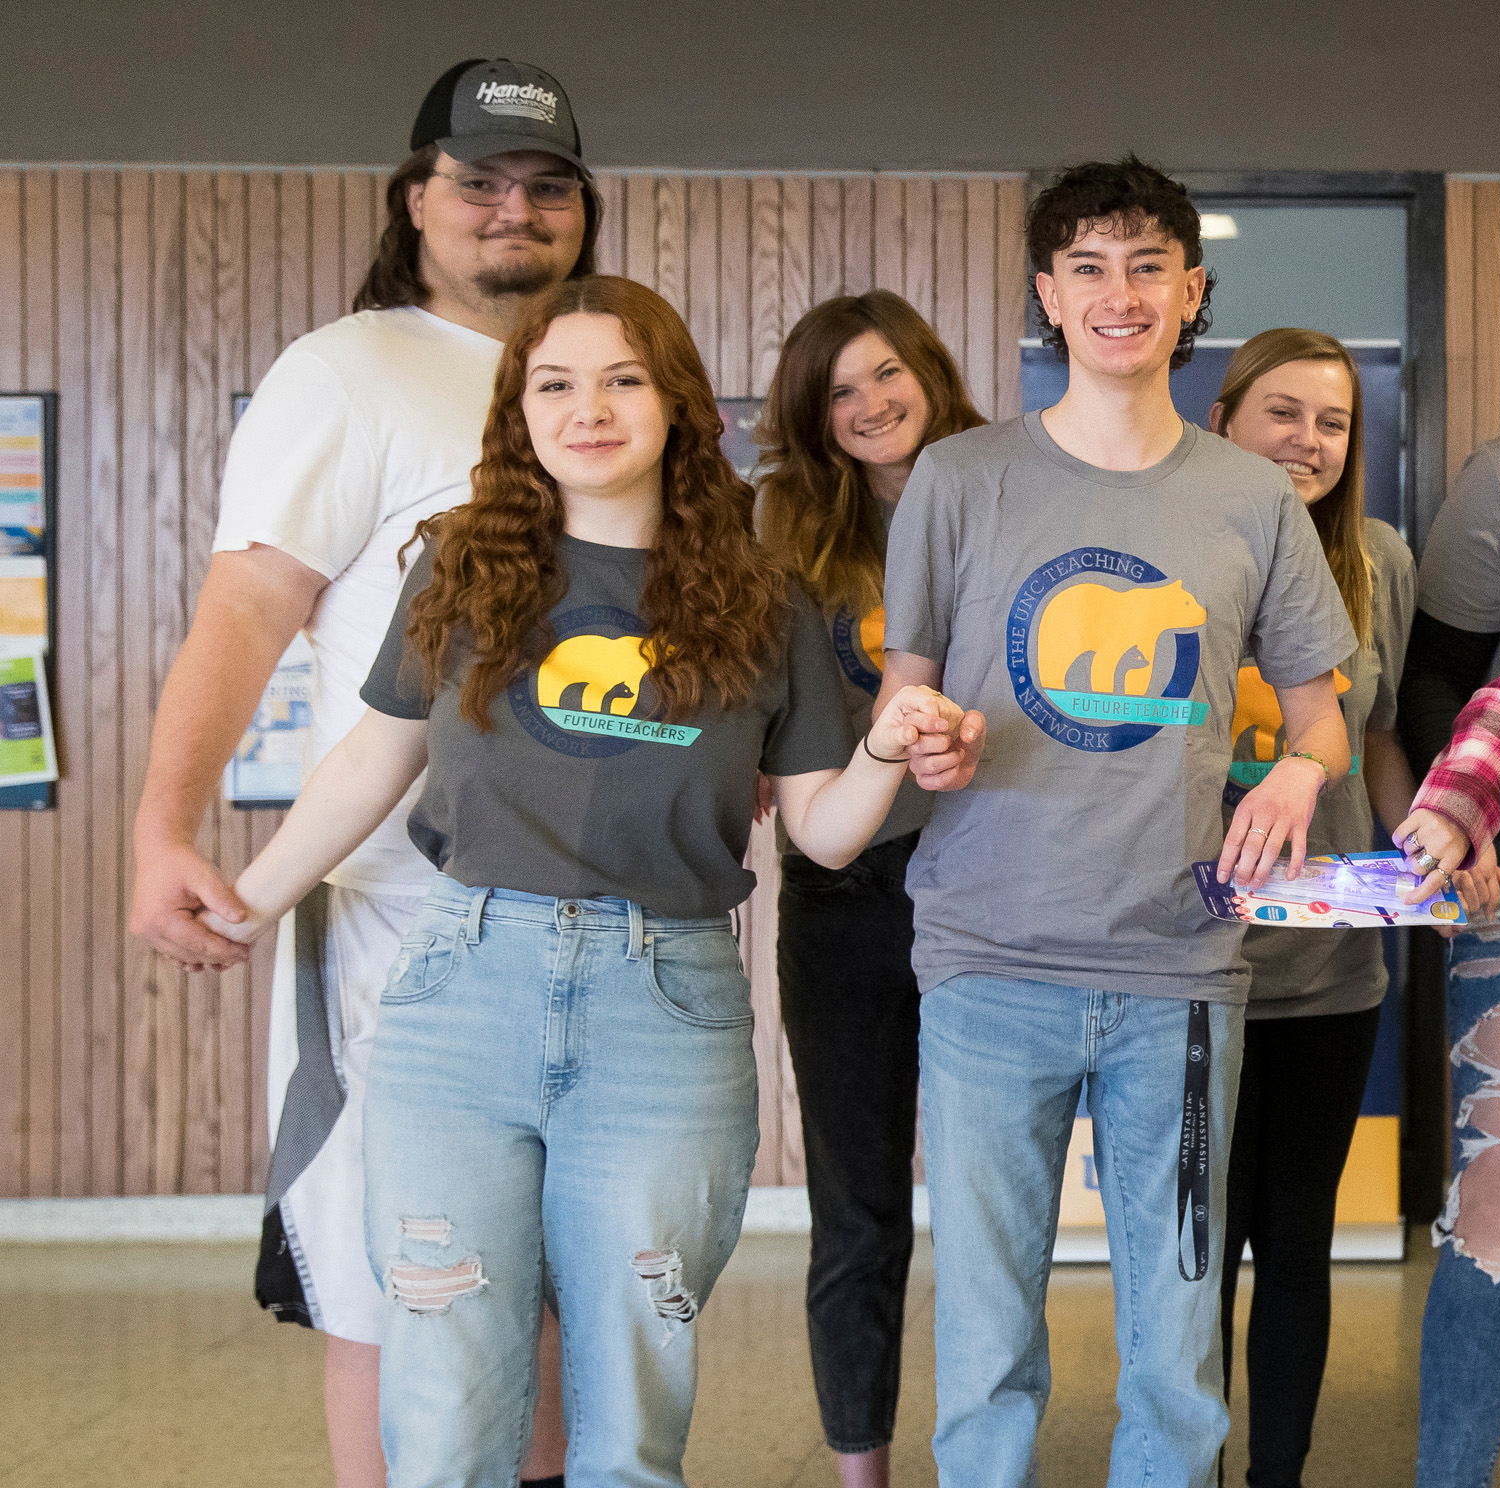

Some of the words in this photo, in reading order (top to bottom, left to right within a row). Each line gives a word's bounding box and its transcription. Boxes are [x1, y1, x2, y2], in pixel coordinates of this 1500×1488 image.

[1043, 552, 1145, 582] TEACHING
[1014, 579, 1045, 621] UNC
[1011, 626, 1026, 668] THE
[1018, 687, 1111, 749] NETWORK
[1072, 697, 1130, 716] FUTURE
[563, 714, 614, 732] FUTURE
[618, 720, 686, 742] TEACHERS
[1182, 1091, 1193, 1170] ANASTASIA
[1199, 1097, 1207, 1176] ANASTASIA
